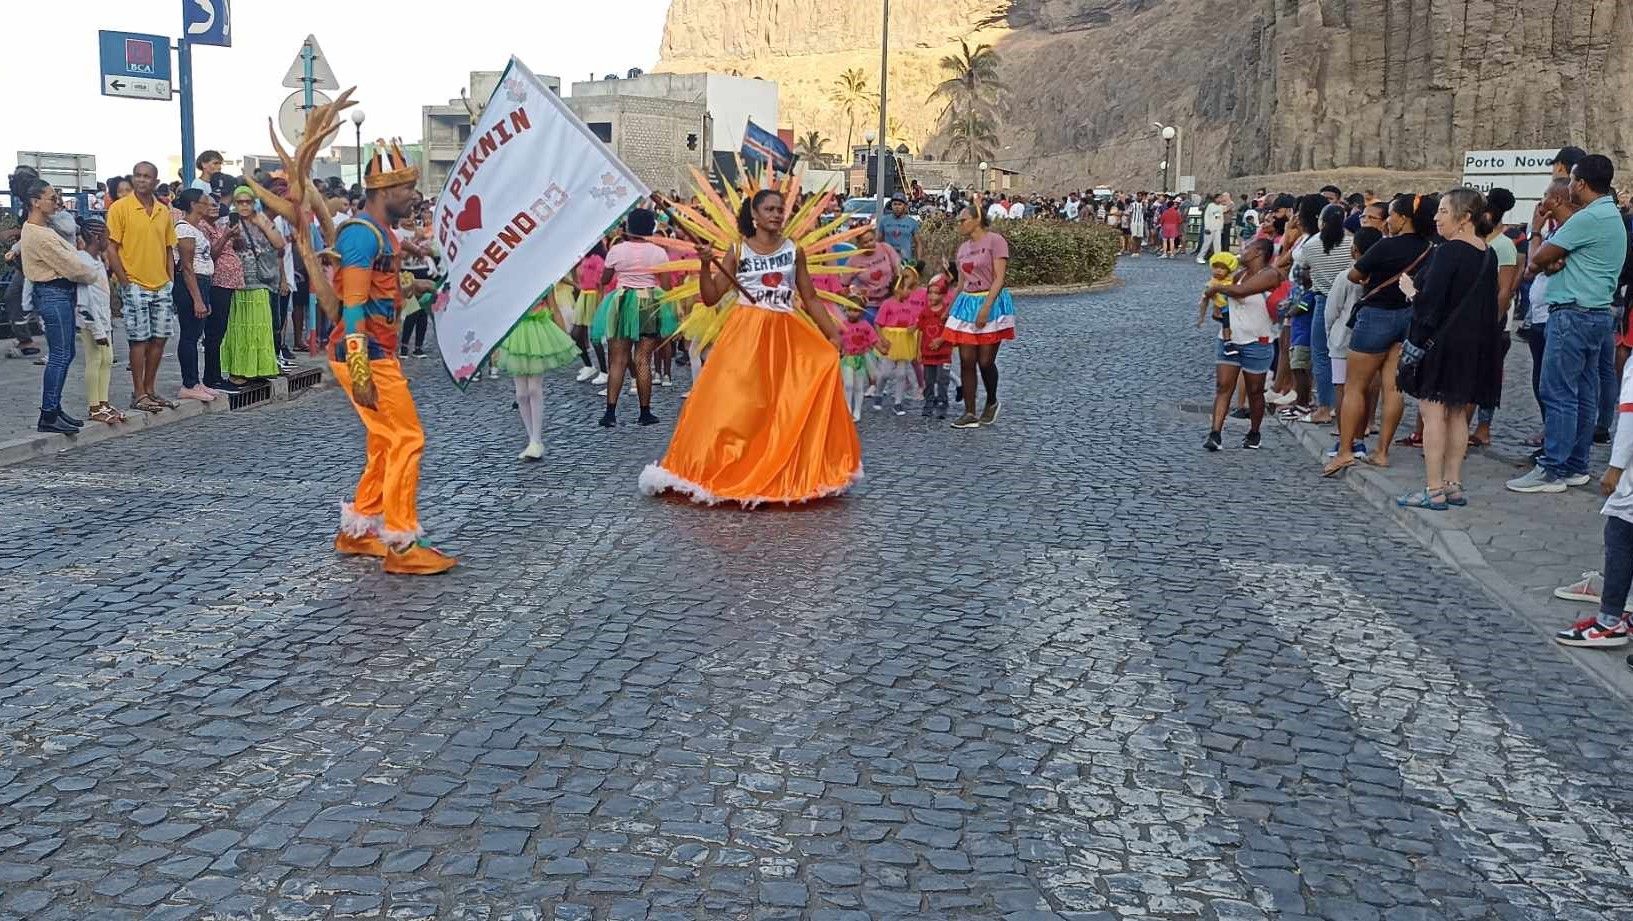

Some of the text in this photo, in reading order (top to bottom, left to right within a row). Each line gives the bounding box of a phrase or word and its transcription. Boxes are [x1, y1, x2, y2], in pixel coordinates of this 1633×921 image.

[130, 63, 151, 73] BCA
[449, 106, 532, 202] PIKNIN
[1465, 156, 1505, 168] Porto
